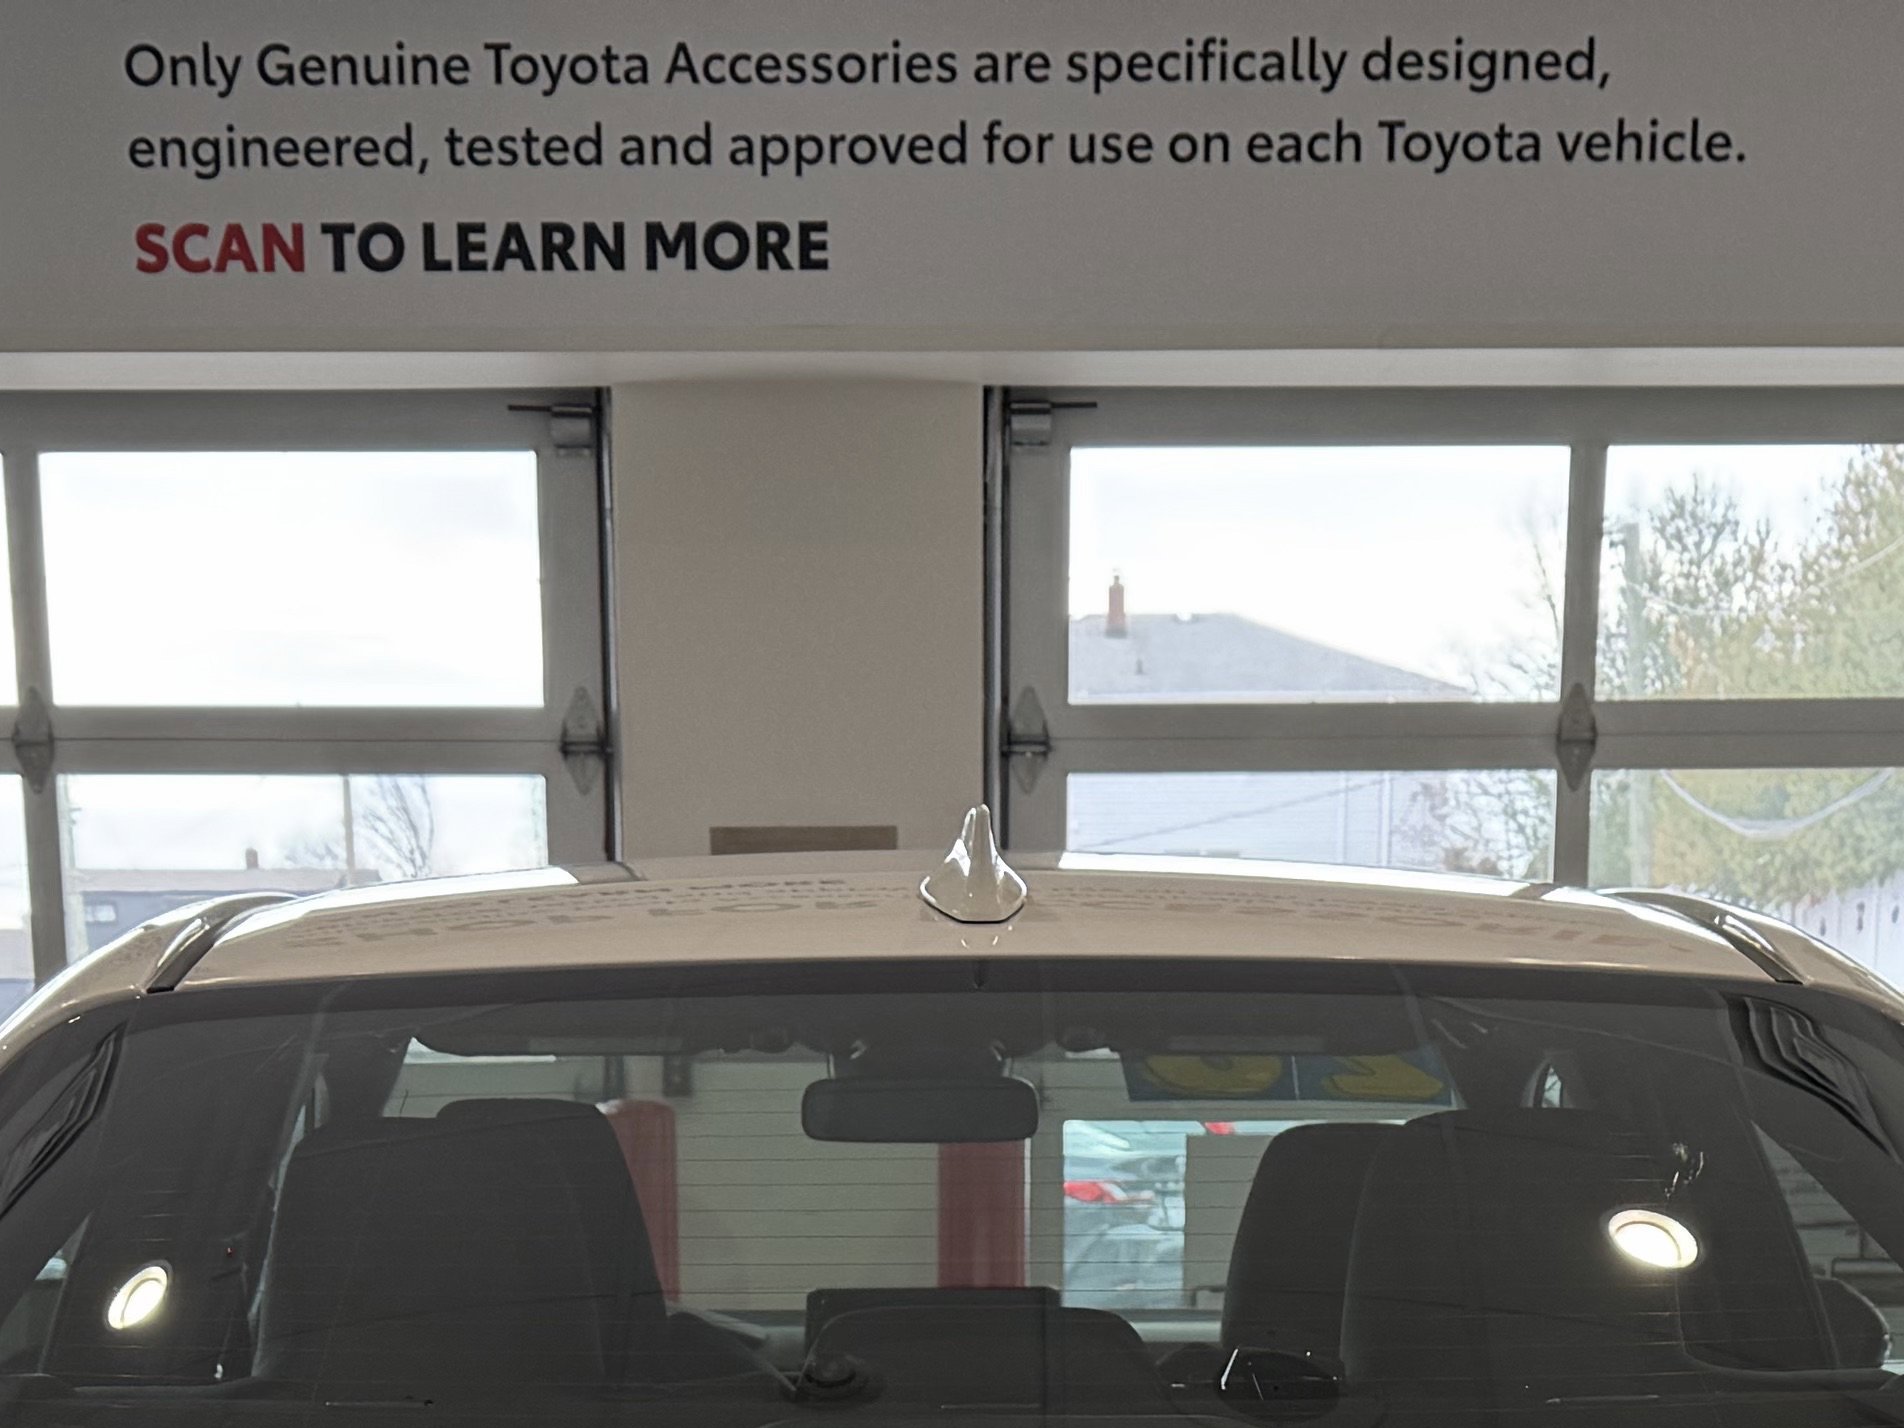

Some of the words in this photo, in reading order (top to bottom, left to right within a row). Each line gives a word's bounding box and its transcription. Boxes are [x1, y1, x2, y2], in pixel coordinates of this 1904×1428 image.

[124, 41, 242, 98] Only
[257, 41, 470, 87] Genuine
[483, 43, 649, 97] Toyota
[665, 40, 958, 86] Accessories
[973, 51, 1051, 84] are
[1066, 37, 1348, 94] specifically
[1362, 36, 1610, 93] designed,
[128, 122, 428, 180] engineered,
[444, 122, 603, 167] tested
[619, 121, 712, 167] and
[729, 120, 967, 177] approved
[982, 120, 1054, 165] for
[1069, 132, 1154, 165] use
[1168, 132, 1230, 164] on
[1246, 119, 1362, 164] each
[1377, 121, 1541, 174] Toyota
[1556, 118, 1746, 163] vehicle.
[135, 222, 306, 274] SCAN
[320, 221, 406, 273] TO
[422, 221, 626, 272] LEARN
[645, 220, 829, 272] MORE
